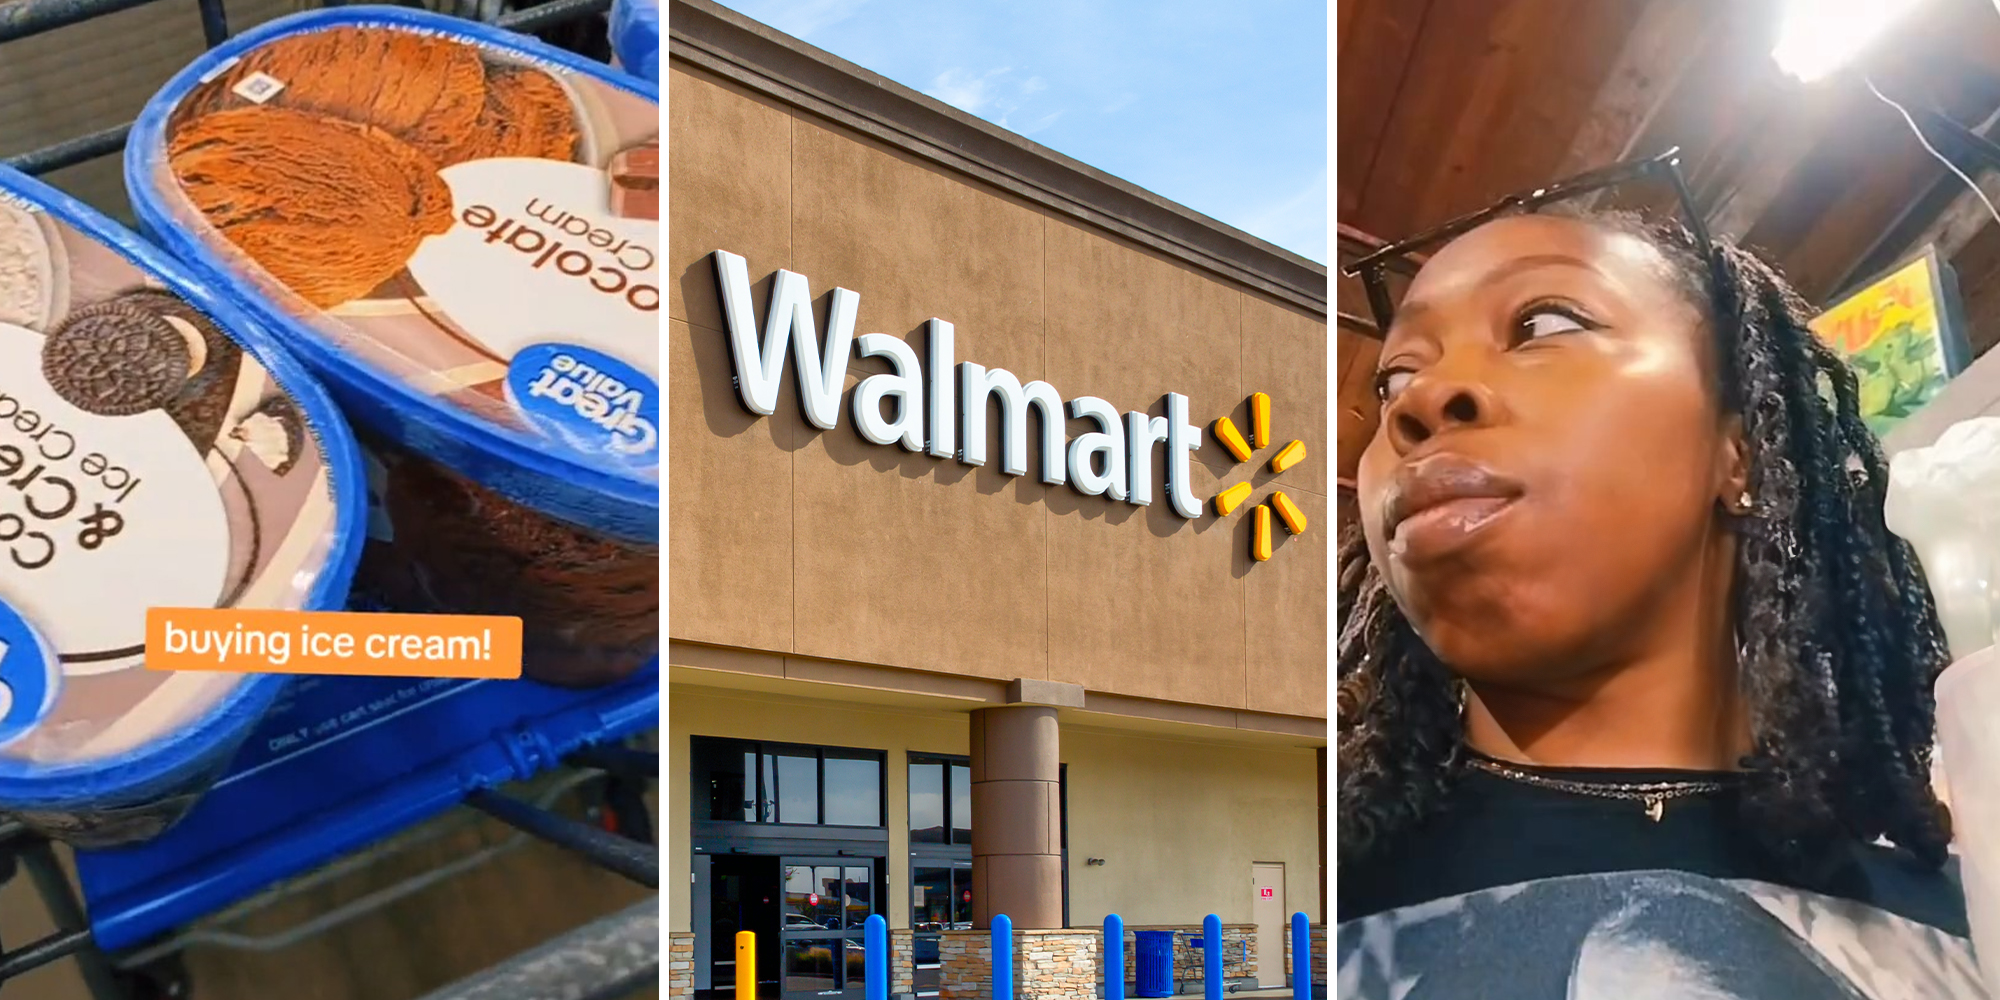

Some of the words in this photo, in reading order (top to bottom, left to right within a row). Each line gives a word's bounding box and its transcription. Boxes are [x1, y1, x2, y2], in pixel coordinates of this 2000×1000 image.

[525, 198, 654, 271] Cream
[528, 367, 657, 454] Great
[551, 354, 644, 413] Value
[710, 249, 1203, 519] Walmart
[80, 452, 141, 503] Ice
[78, 502, 124, 550] &
